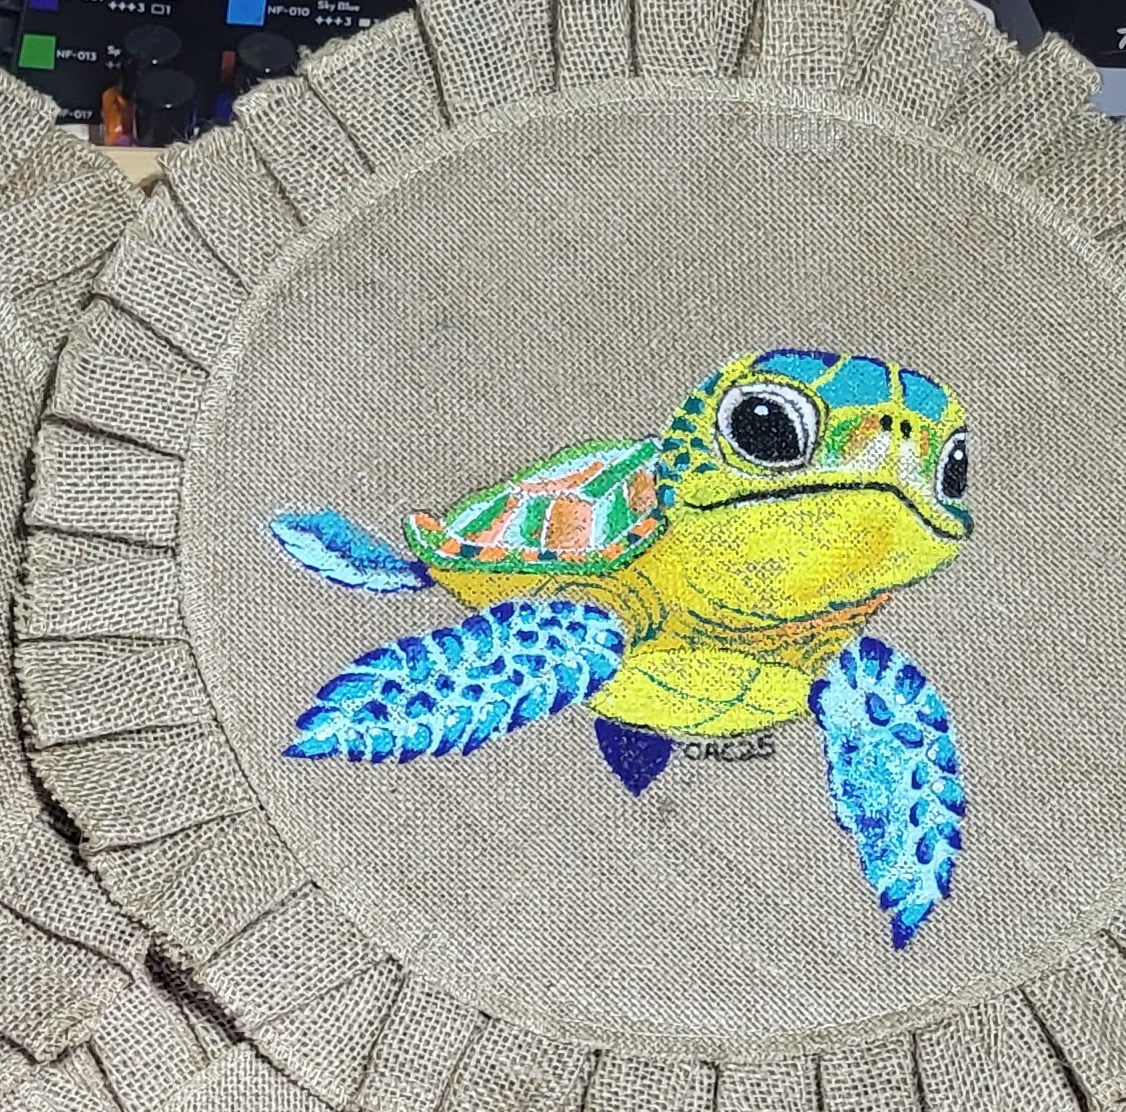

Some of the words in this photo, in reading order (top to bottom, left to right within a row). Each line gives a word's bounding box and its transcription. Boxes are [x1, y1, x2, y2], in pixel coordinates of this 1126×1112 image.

[267, 5, 311, 17] NF-010
[317, 0, 336, 11] Sky
[337, 1, 360, 12] Blue
[56, 49, 98, 62] NF-013
